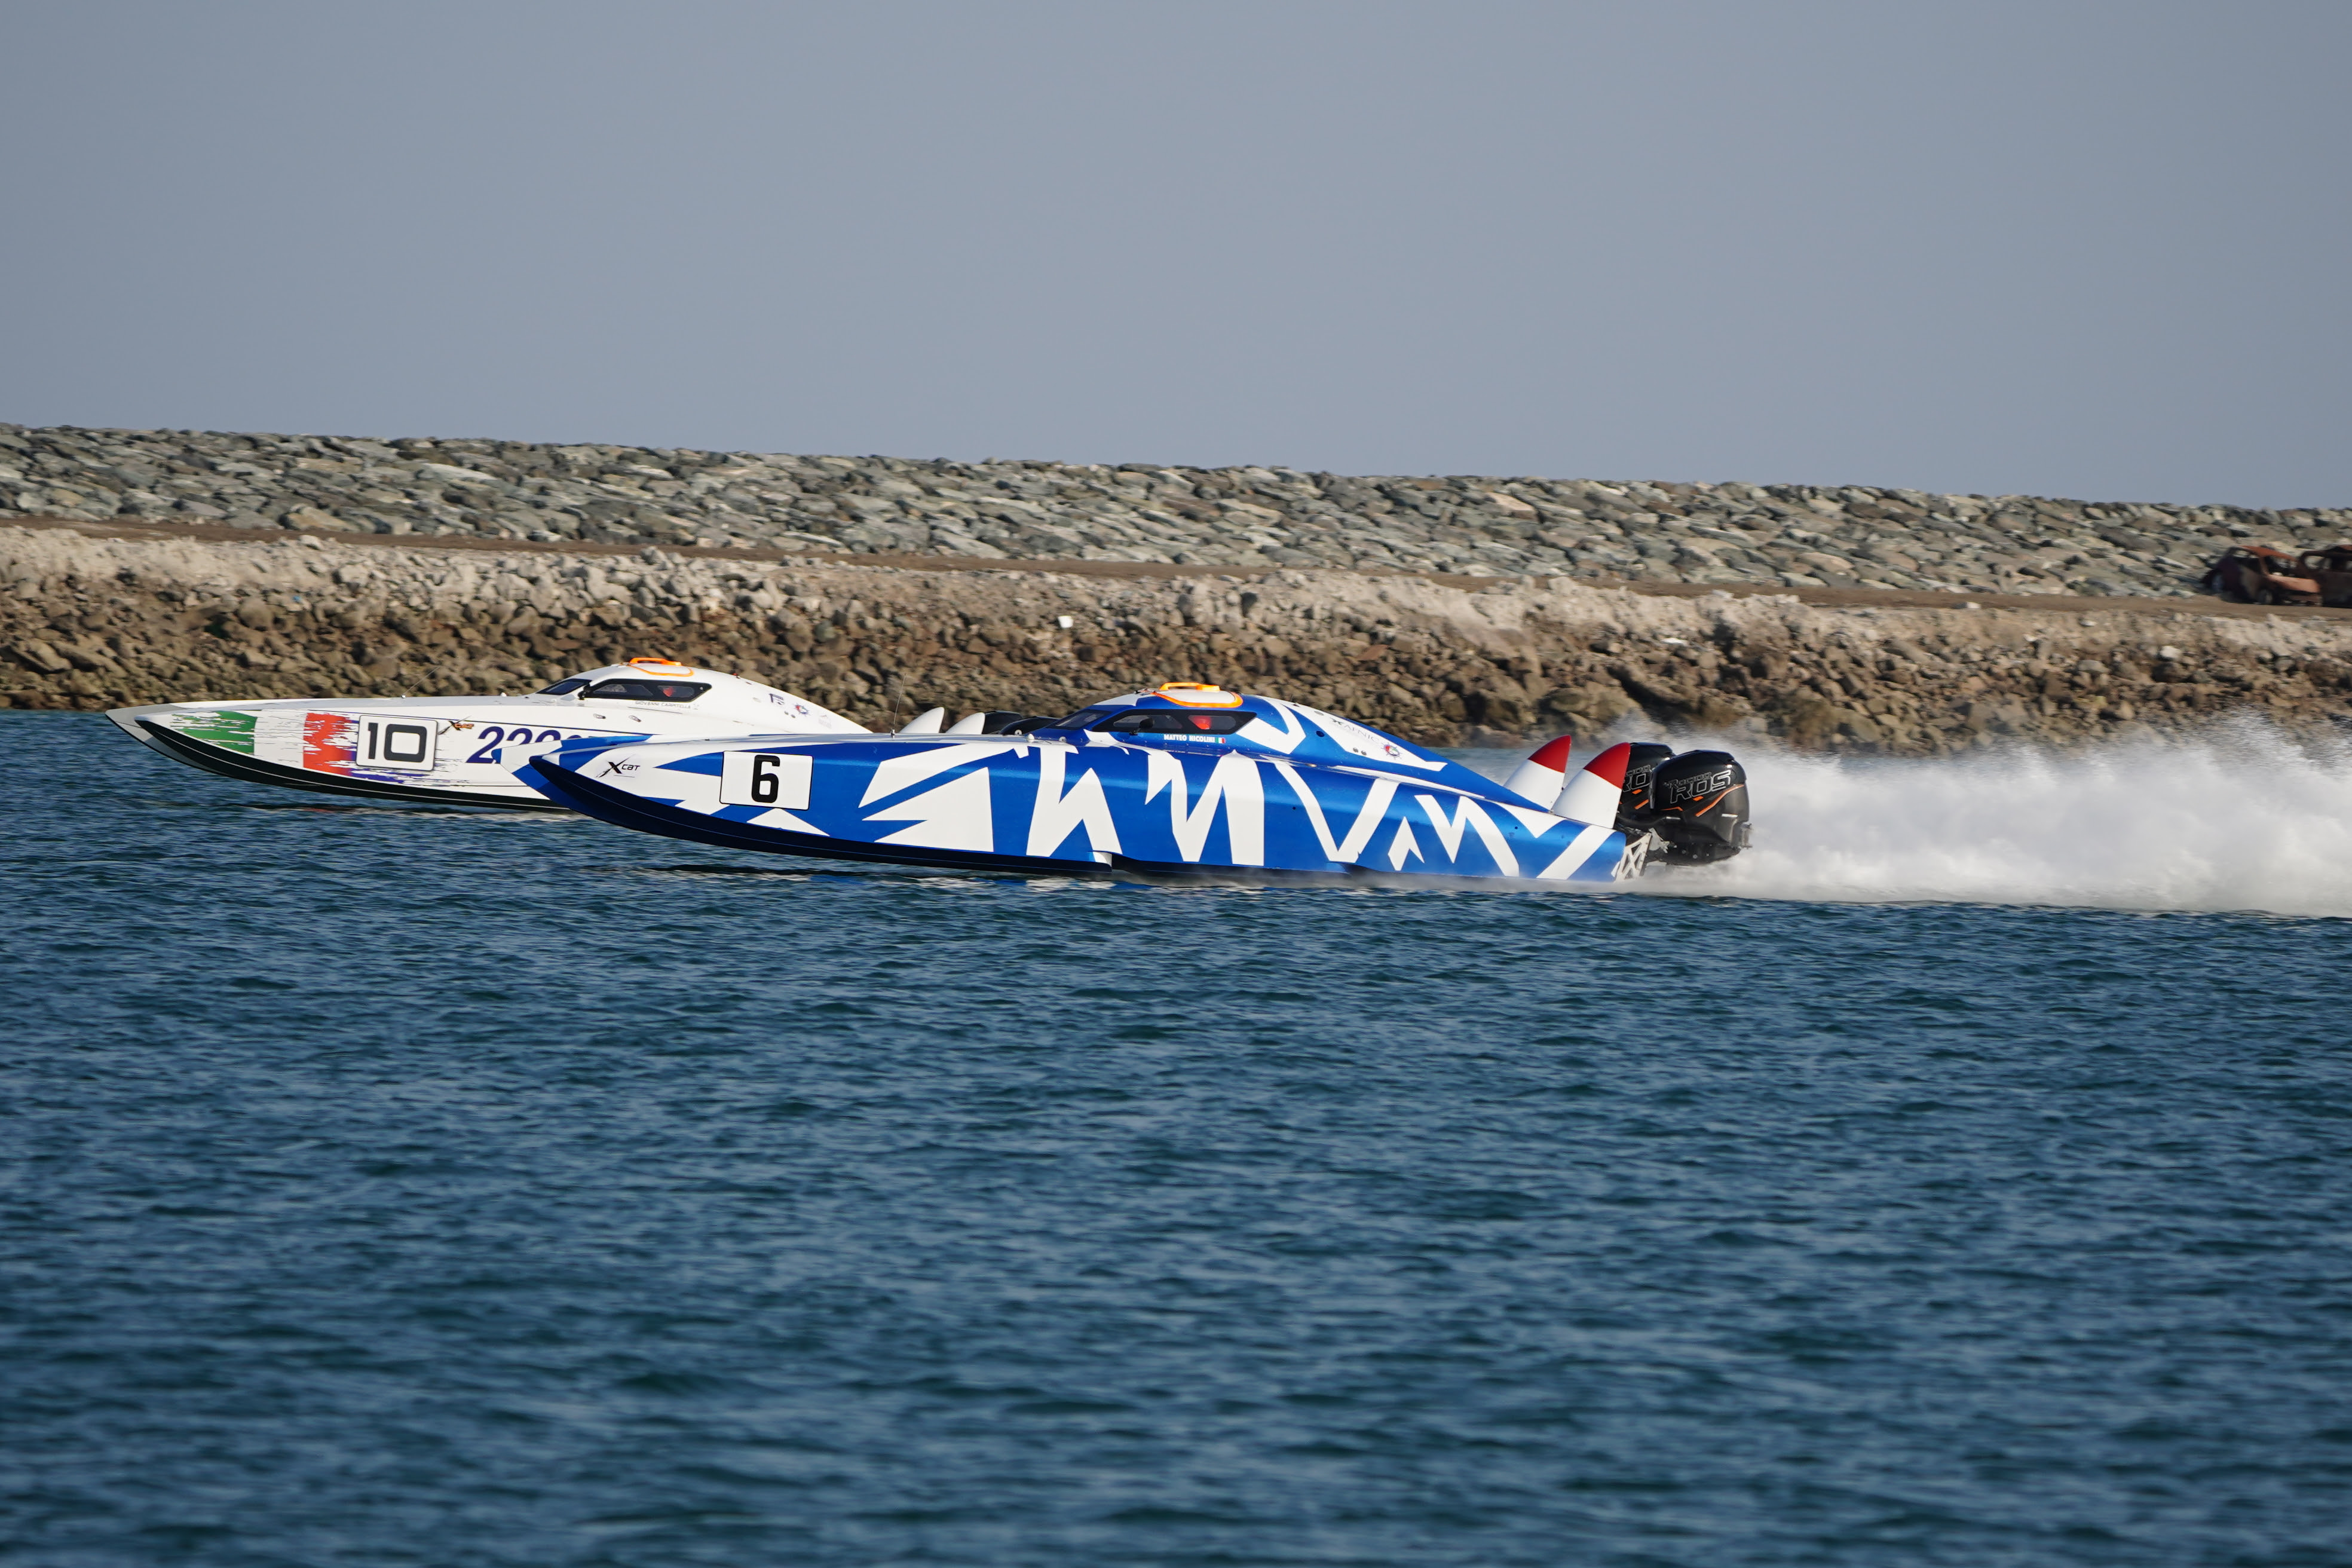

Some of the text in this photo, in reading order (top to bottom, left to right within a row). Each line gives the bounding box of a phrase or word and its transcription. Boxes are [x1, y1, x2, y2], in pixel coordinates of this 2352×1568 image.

[368, 722, 427, 763] 10
[751, 754, 780, 804] 6
[1670, 769, 1732, 804] ROS
